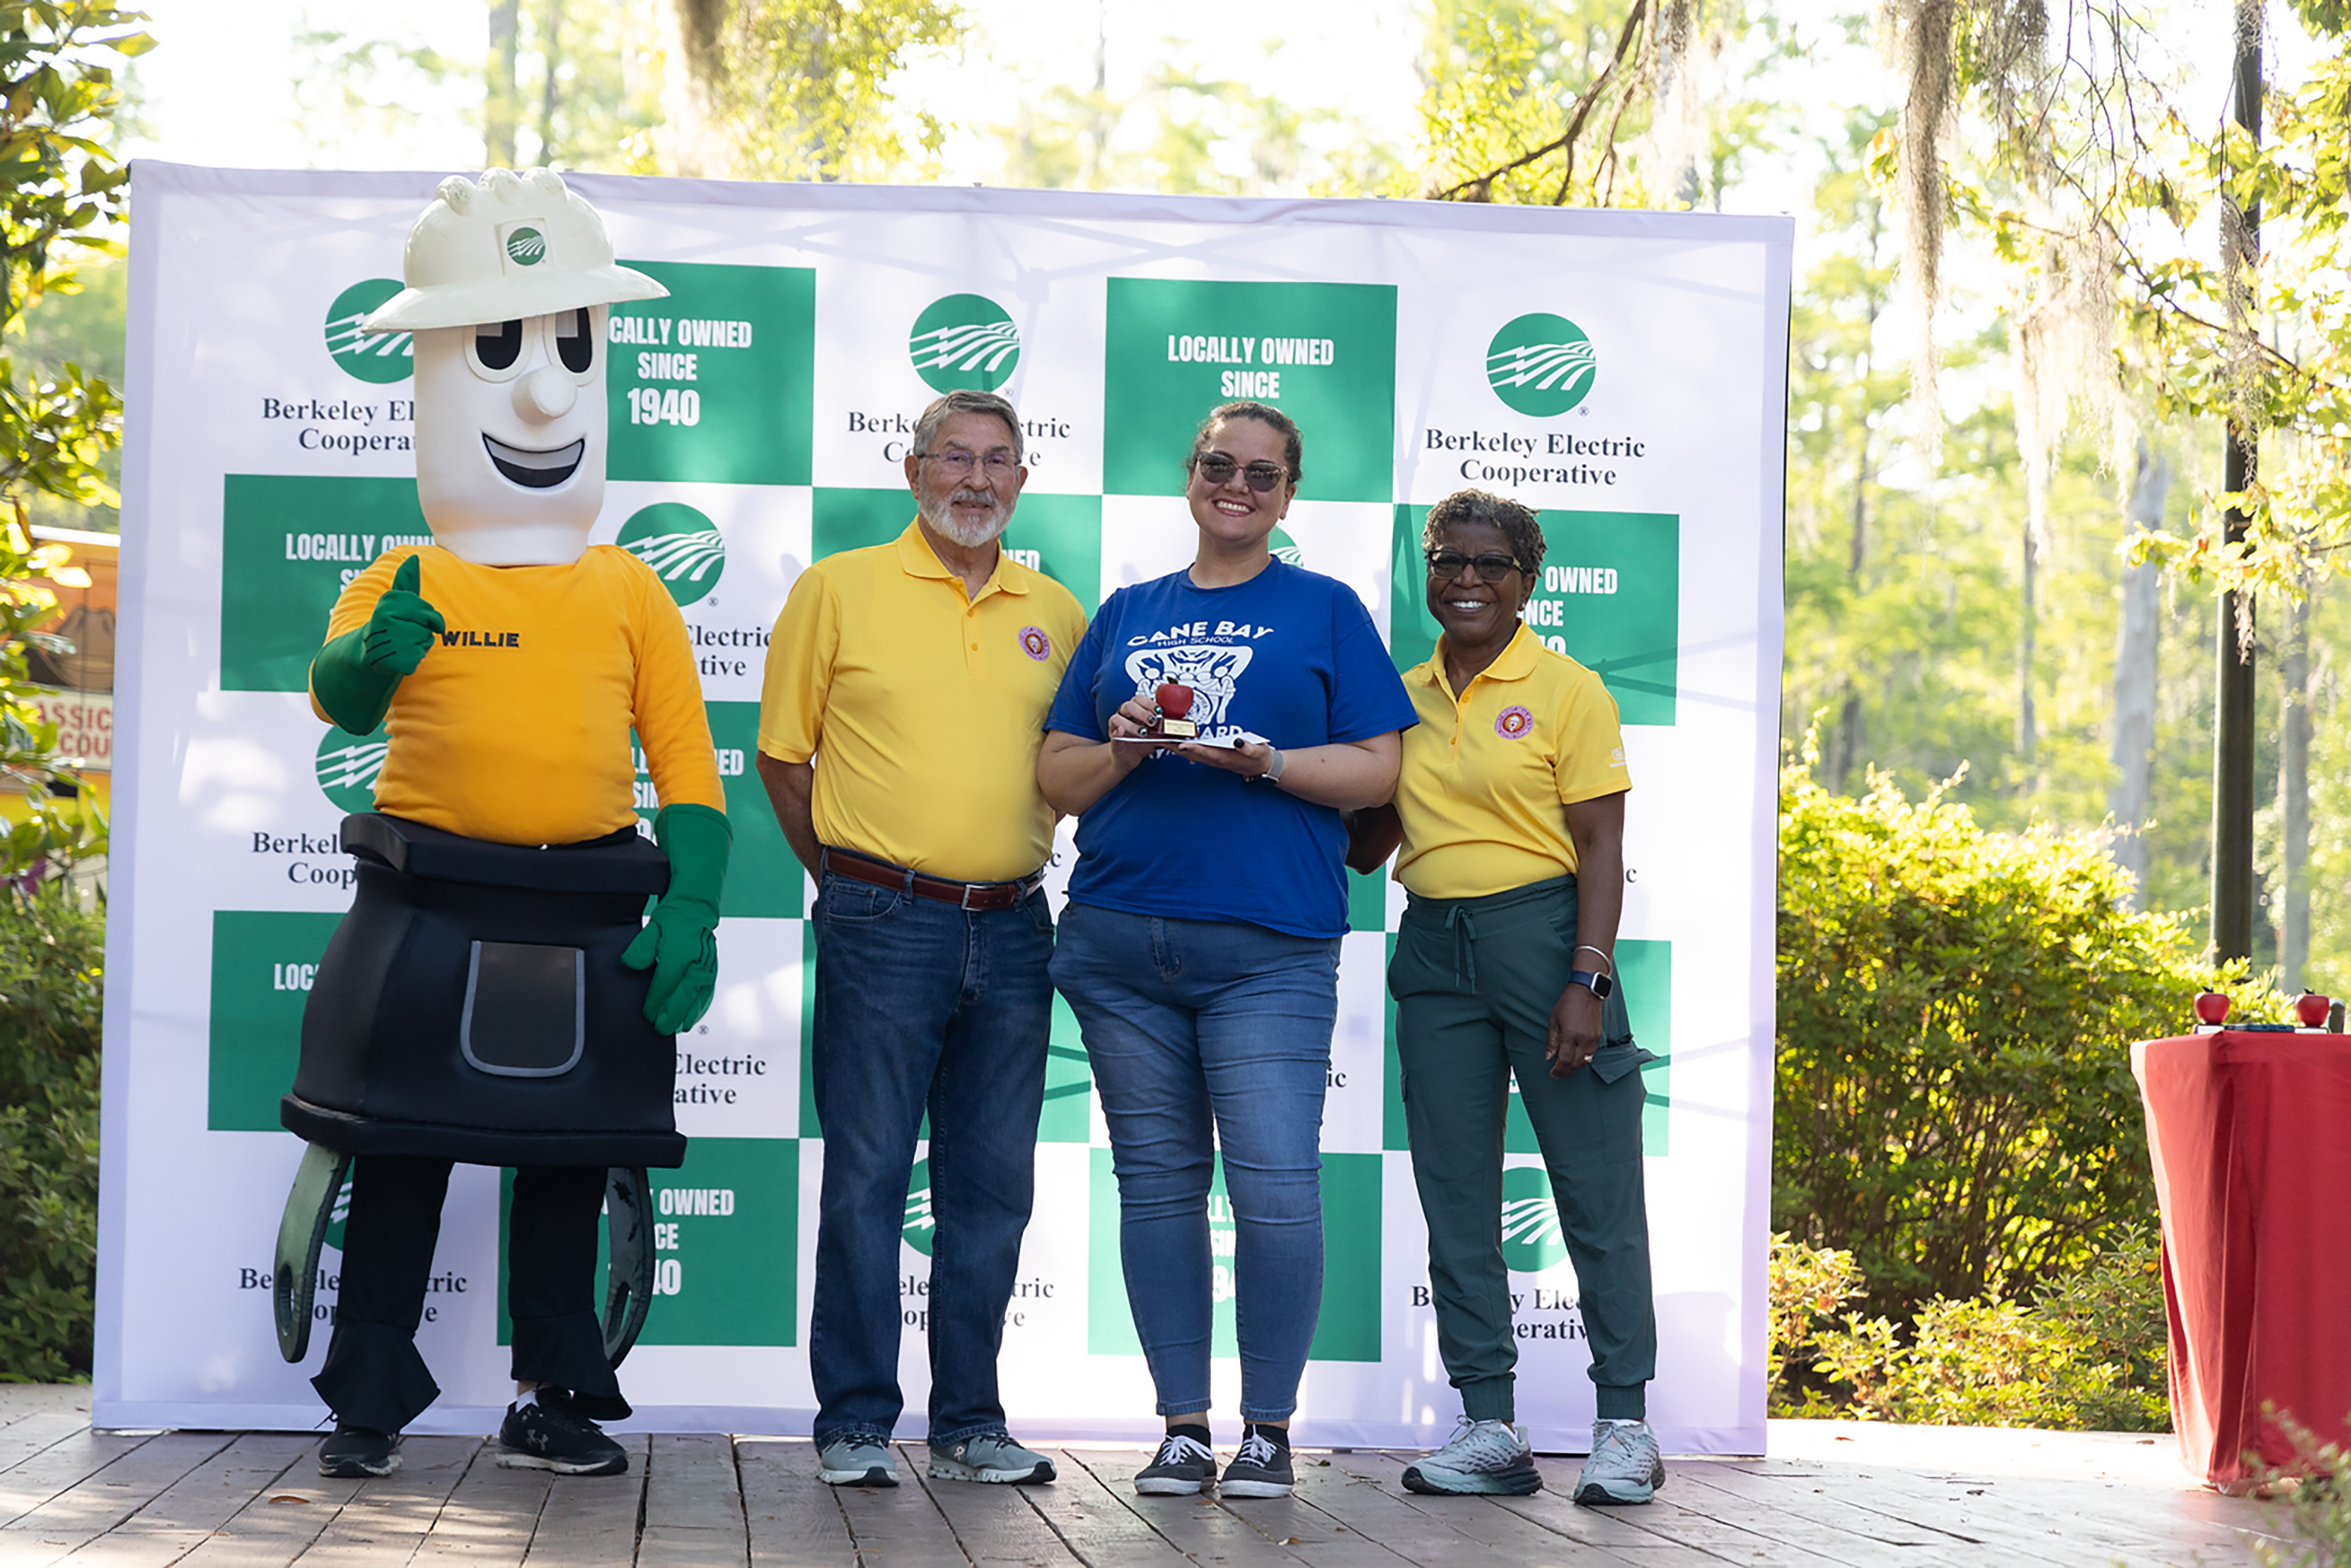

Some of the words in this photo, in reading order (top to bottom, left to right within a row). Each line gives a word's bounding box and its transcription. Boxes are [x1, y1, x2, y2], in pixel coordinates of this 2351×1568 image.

[609, 316, 672, 345] CALLY
[678, 319, 753, 348] OWNED
[1167, 334, 1256, 363] LOCALLY
[1260, 337, 1335, 365] OWNED
[637, 351, 698, 381] SINCE
[1220, 370, 1280, 399] SINCE
[262, 397, 378, 427] Berkeley
[626, 387, 700, 426] 1940
[846, 411, 919, 433] Berk
[1019, 418, 1071, 438] tric
[298, 427, 416, 456] Coopera
[1426, 428, 1538, 458] Berkeley
[1547, 433, 1646, 457] Electric
[1459, 458, 1617, 487] Cooperative
[285, 533, 375, 561] LOCALLY
[1545, 565, 1618, 595] OWNED
[1522, 599, 1565, 626] NCE
[442, 631, 520, 648] WILLIE
[1127, 621, 1208, 646] CANE
[1214, 620, 1274, 639] BAY
[1158, 638, 1186, 647] HIGH
[1190, 636, 1234, 645] SCHOOL
[251, 831, 339, 855] Berkel
[659, 1188, 735, 1216] OWNED
